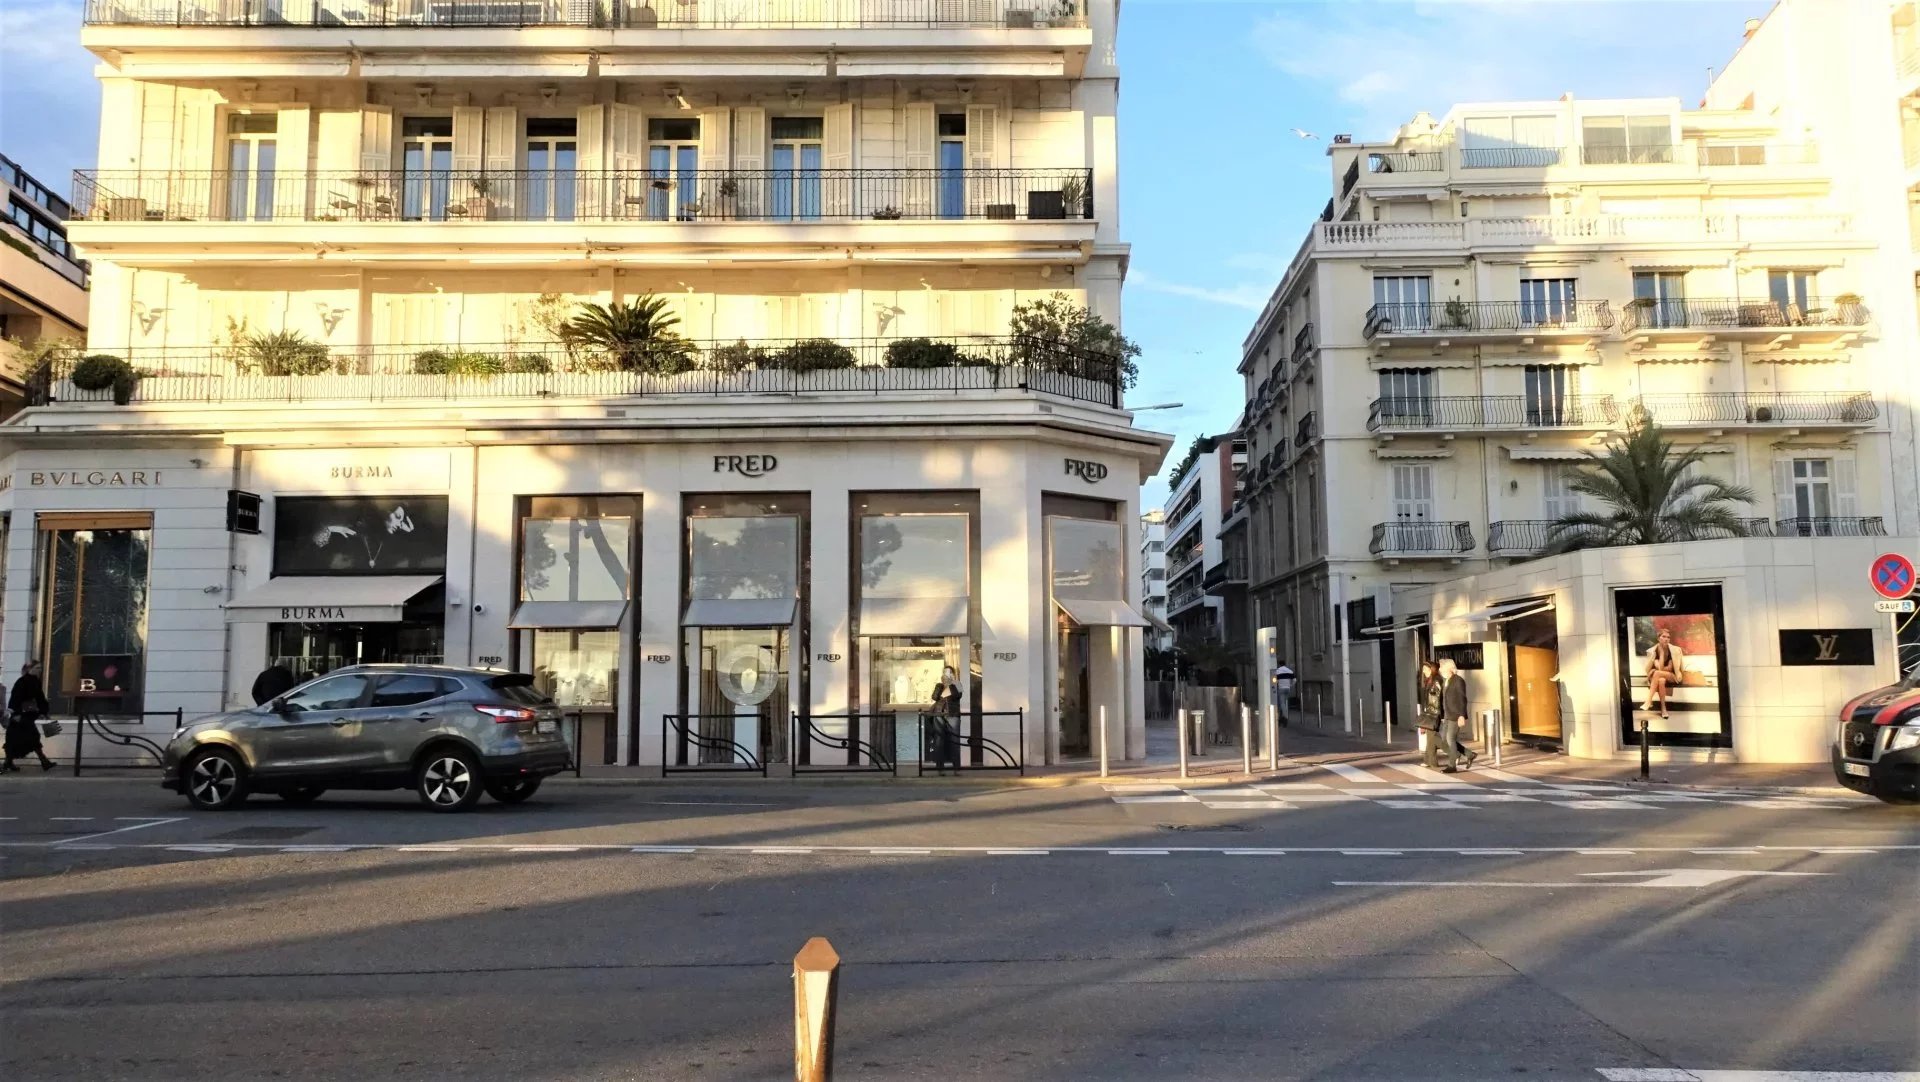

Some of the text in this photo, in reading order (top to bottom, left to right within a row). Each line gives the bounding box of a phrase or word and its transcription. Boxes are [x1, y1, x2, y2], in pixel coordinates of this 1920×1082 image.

[331, 466, 393, 479] BURMA
[713, 455, 777, 478] FRED
[1064, 458, 1108, 484] FRED
[31, 472, 162, 486] BVLGARI
[281, 607, 345, 619] BURMA
[478, 656, 502, 665] FRED
[647, 654, 671, 664] FRED
[817, 653, 841, 662] FRED
[993, 652, 1017, 661] FRED
[80, 678, 97, 692] B
